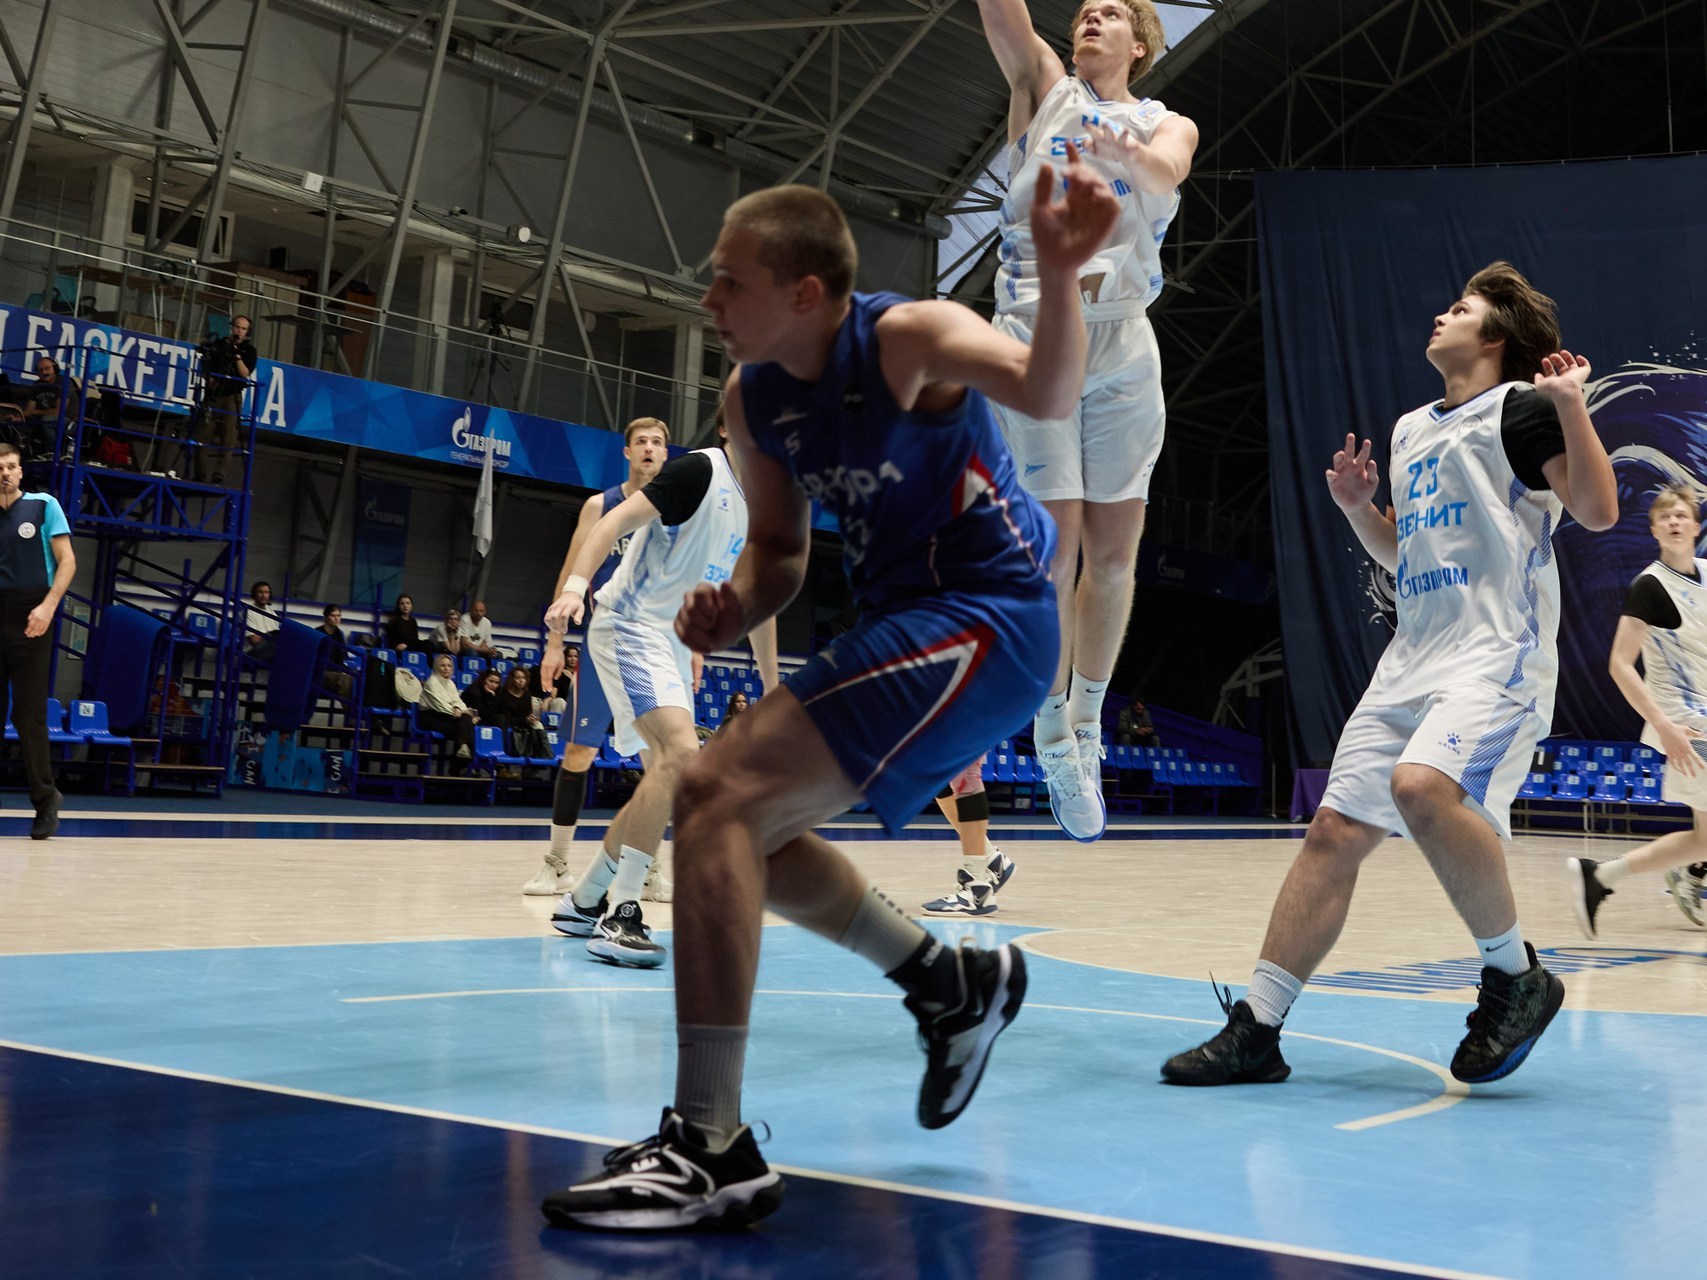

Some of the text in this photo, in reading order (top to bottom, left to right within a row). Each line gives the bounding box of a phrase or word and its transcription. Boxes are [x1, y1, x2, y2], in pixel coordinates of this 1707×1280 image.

[1408, 456, 1440, 502] 23
[1396, 501, 1469, 543] ЗЕНИТ
[1410, 566, 1469, 597] ГАЗПРОМ
